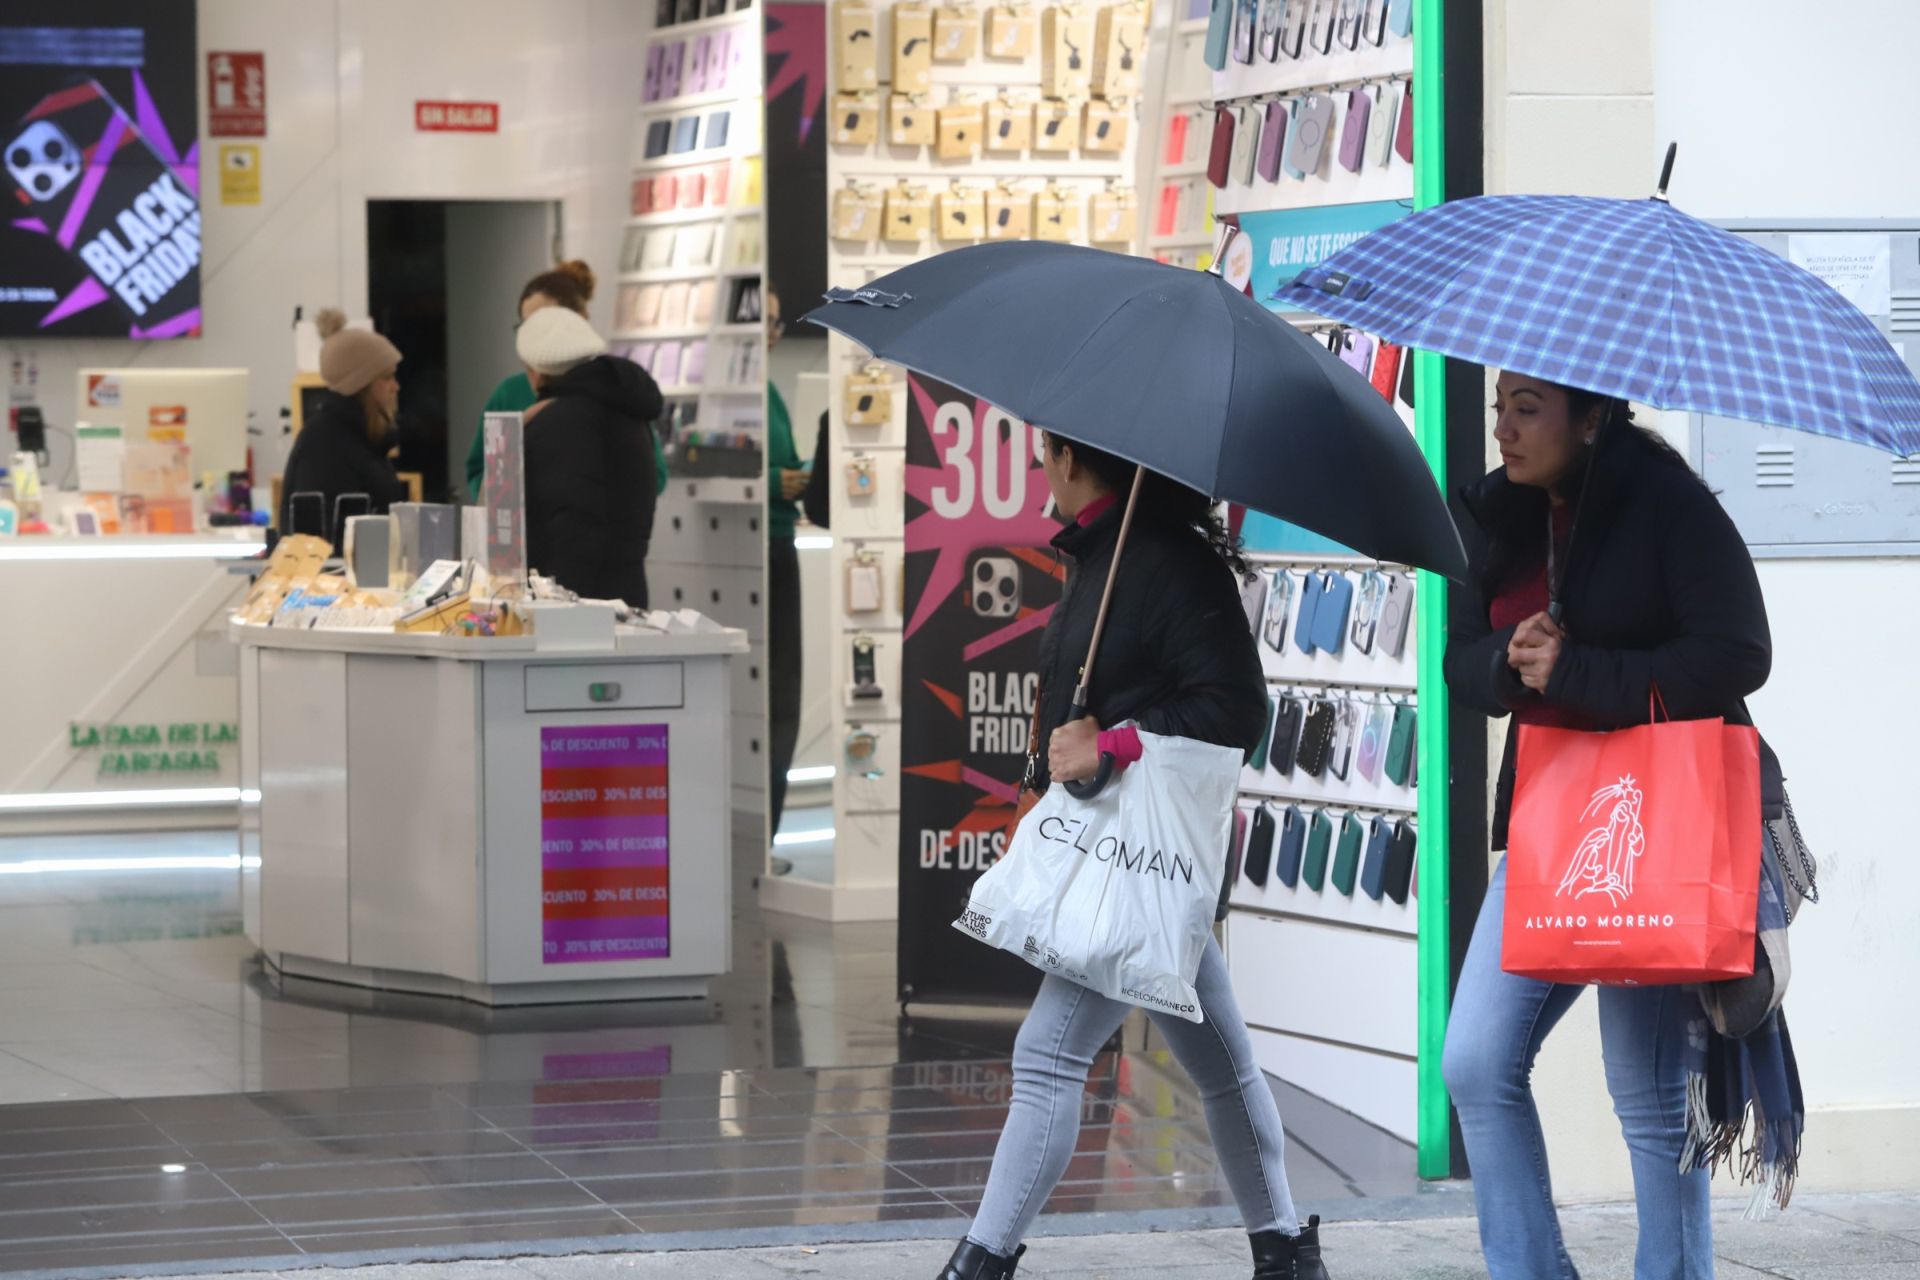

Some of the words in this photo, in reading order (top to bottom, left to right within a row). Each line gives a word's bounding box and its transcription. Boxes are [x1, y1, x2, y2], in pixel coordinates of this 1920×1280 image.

[446, 106, 494, 127] SALIDA
[79, 172, 196, 287] BLACK
[1269, 236, 1290, 267] QUE
[1290, 235, 1306, 265] NO
[1305, 234, 1320, 263] SE
[968, 671, 1039, 714] BLAC
[70, 724, 101, 748] LA
[106, 723, 162, 746] CASA
[567, 736, 630, 752] DESCUENTO
[970, 716, 1032, 754] FRID
[629, 786, 643, 800] DE
[606, 838, 619, 851] DE
[920, 829, 952, 869] DE
[958, 830, 1006, 871] DES
[1039, 816, 1193, 884] CELOMAN
[619, 887, 633, 901] DE
[970, 918, 986, 930] TUS
[1525, 914, 1588, 929] ALVARO
[1597, 913, 1675, 928] MORENO
[1046, 954, 1057, 966] 70
[1121, 986, 1196, 1013] #CELOPMANECO
